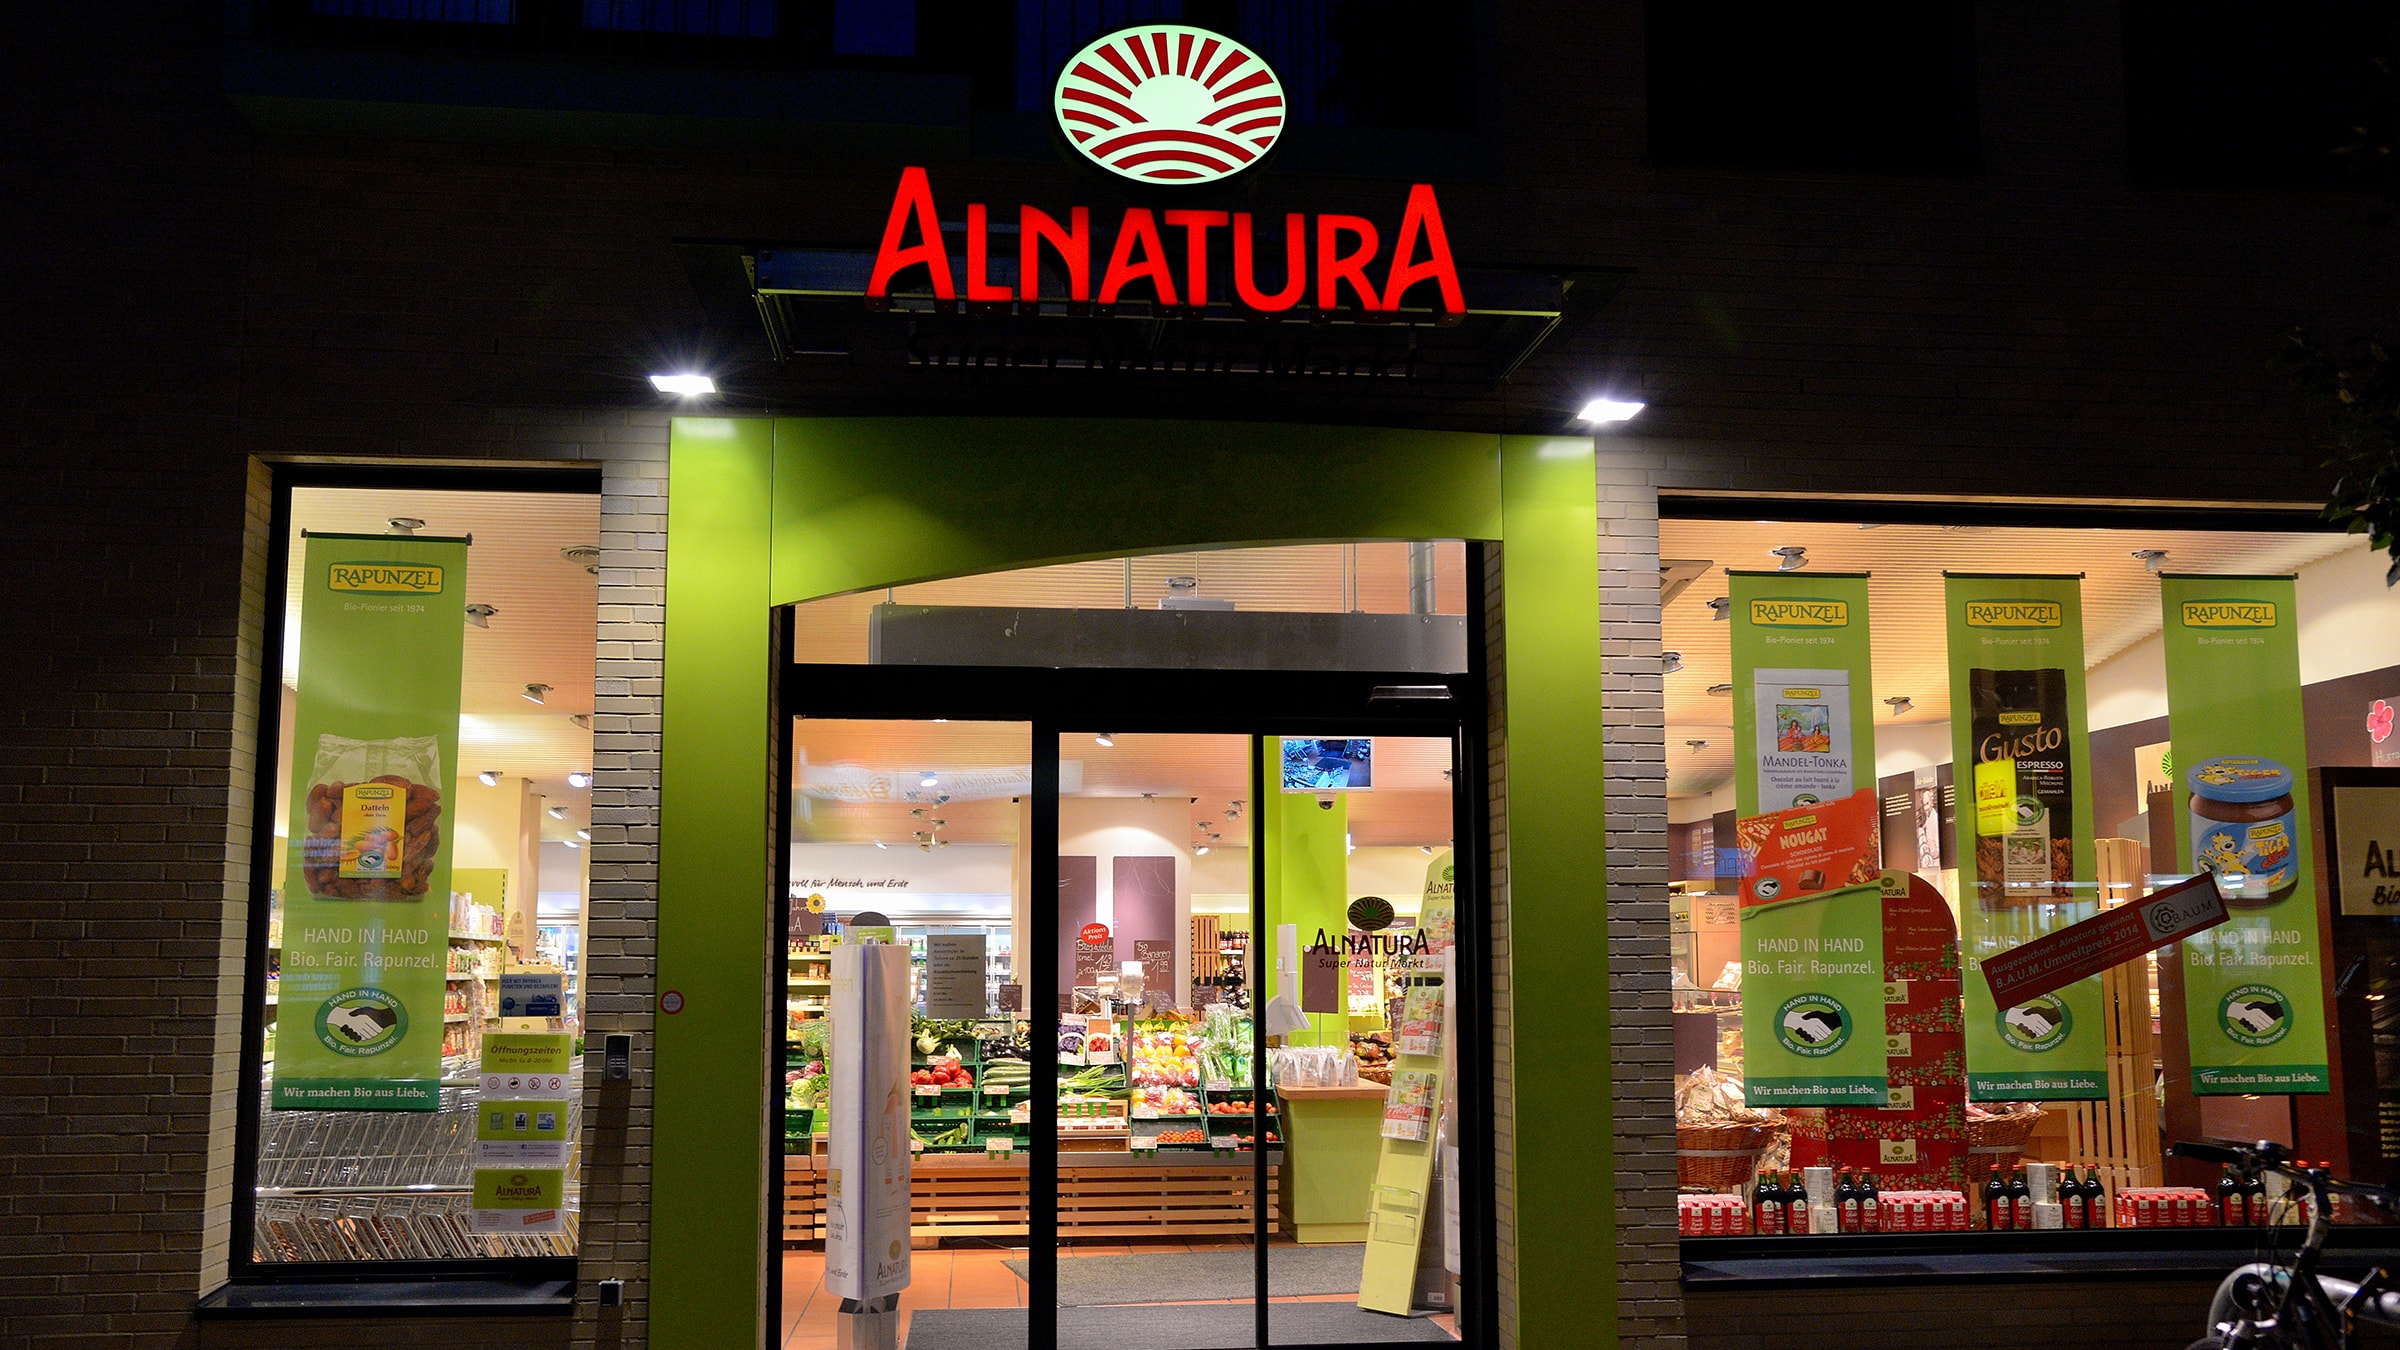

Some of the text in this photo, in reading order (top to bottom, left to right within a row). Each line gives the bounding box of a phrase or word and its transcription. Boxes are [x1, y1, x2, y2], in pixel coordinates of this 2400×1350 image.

[864, 167, 1467, 313] ALNATURA
[334, 568, 439, 589] RAPUNZEL
[344, 602, 425, 614] Bio-Pionier seit 1974
[1754, 604, 1845, 623] RAPUNZEL
[1970, 606, 2058, 623] RAPUNZEL
[2186, 606, 2273, 623] RAPUNZEL
[1765, 635, 1835, 645] Bio-Pionier seit 1974
[1981, 636, 2050, 645] Bio-Pionier seit 1974
[2198, 636, 2265, 645] Bio-Pionier seit 1974
[2000, 714, 2040, 723] RAPUNZEL
[1980, 726, 2062, 764] Gusto
[1762, 755, 1847, 768] MANDEL-TONKA
[2016, 761, 2064, 769] ESPRESSO
[361, 804, 389, 812] Datteln
[1779, 827, 1828, 850] NOUGAT
[1789, 846, 1823, 858] SCHOKOLADE
[810, 879, 827, 889] für
[827, 878, 864, 889] Mensch
[866, 879, 886, 888] und
[887, 879, 909, 888] Erde
[304, 927, 428, 945] HAND IN HAND
[1082, 926, 1107, 936] Aktions
[1087, 933, 1103, 941] Preis
[2199, 930, 2301, 945] HAND IN HAND
[1312, 928, 1430, 956] ALNATURA
[1758, 938, 1864, 953] HAND IN HAND
[1991, 943, 2057, 976] Ausgezeichnet:
[2059, 929, 2097, 948] Alnatura
[2098, 912, 2135, 934] gewinnt
[290, 951, 440, 971] Bio. Fair. Rapunzel.
[1995, 963, 2043, 989] B.A.U.M.
[2043, 936, 2112, 970] Umweltpreis
[2114, 923, 2139, 942] 2014
[2190, 951, 2313, 969] Bio. Fair. Rapunzel.
[1318, 958, 1424, 971] Super Natur Markt
[1747, 959, 1876, 977] Bio. Fair. Rapunzel.
[328, 991, 356, 1007] HAND
[370, 990, 398, 1008] HAND
[2225, 986, 2249, 1002] HAND
[2261, 987, 2284, 1002] HAND
[1783, 996, 1808, 1012] HAND
[1820, 996, 1843, 1012] HAND
[323, 1035, 399, 1055] Bio. Fair. Rapunzel.
[490, 1045, 562, 1056] Öffnungszeiten
[1782, 1038, 1796, 1050] Bio.
[1813, 1037, 1847, 1055] Rapunzel.
[1977, 1079, 2098, 1090] Wir machen Bio aus Liebe.
[2200, 1072, 2320, 1084] Wir machen Bio aus Liebe.
[283, 1086, 429, 1098] Wir machen Bio aus Liebe.
[1753, 1084, 1878, 1095] Wir machen Bio aus Liebe.
[1883, 1154, 1914, 1162] ALNATURA
[496, 1185, 542, 1196] ALNATURA
